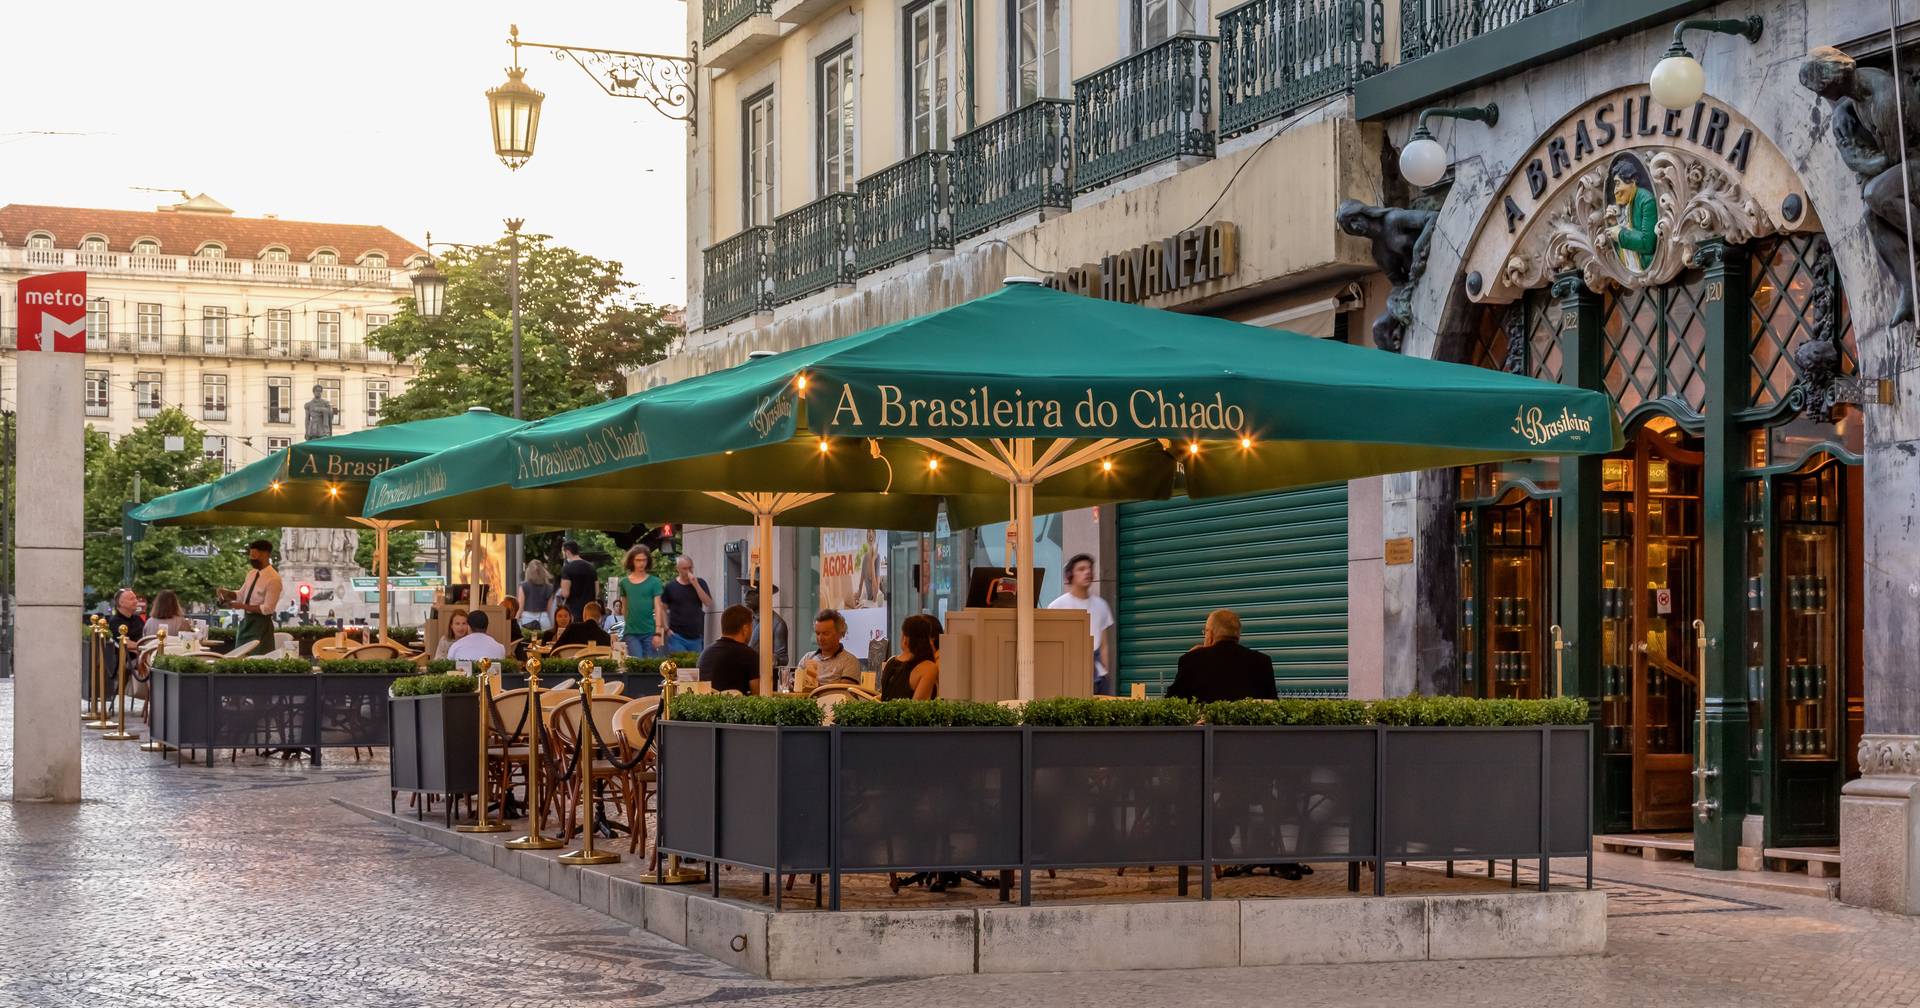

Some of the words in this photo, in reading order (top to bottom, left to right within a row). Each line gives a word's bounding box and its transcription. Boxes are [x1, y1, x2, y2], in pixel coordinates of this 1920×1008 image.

[1504, 195, 1526, 234] A
[1525, 95, 1753, 200] BRASILEIRA
[1100, 220, 1234, 302] HAVANEZA
[25, 289, 84, 307] metro
[1705, 281, 1723, 302] 120
[832, 383, 863, 426] A
[877, 384, 1063, 428] Brasileira
[1074, 388, 1118, 428] do
[1129, 387, 1244, 431] Chiado
[1511, 404, 1535, 440] A
[1526, 405, 1592, 446] Brasileira
[301, 453, 318, 474] A
[517, 446, 529, 479] A
[530, 440, 590, 478] Brasileira
[586, 433, 607, 465] do
[601, 420, 649, 461] Chiado
[823, 553, 854, 578] AGORA
